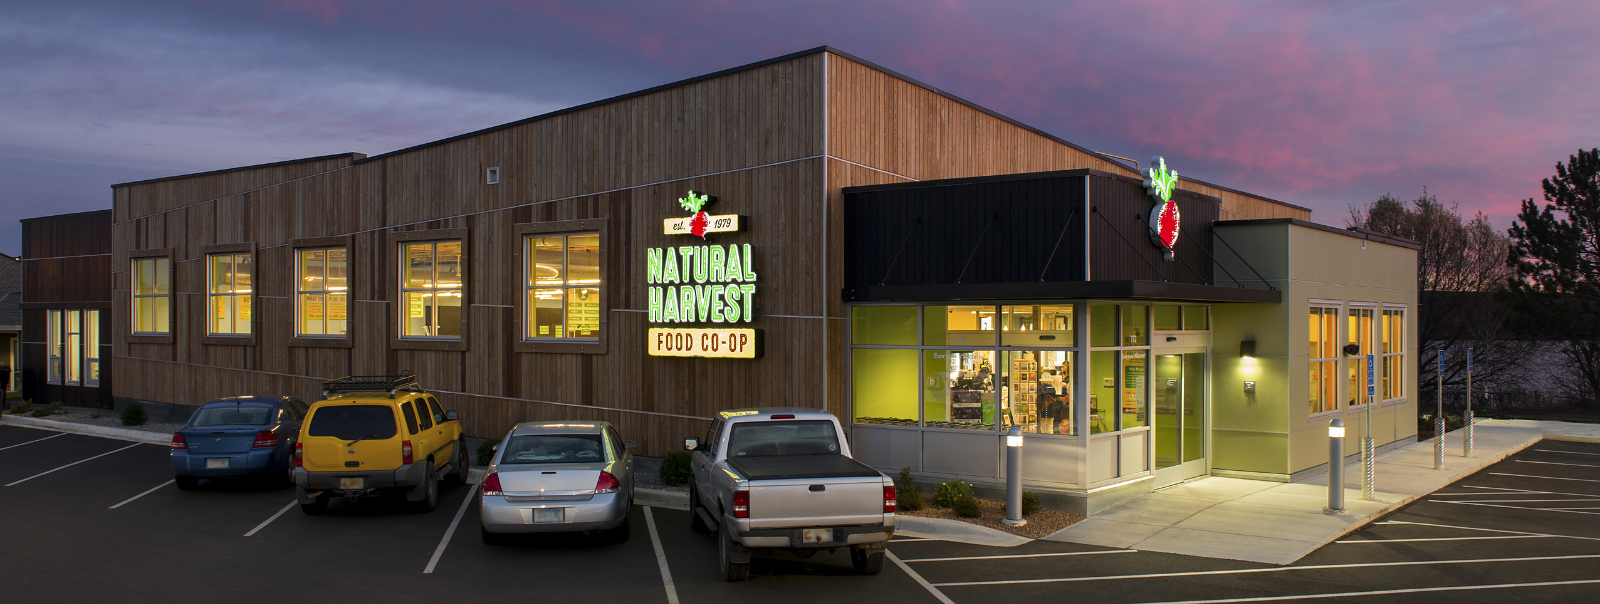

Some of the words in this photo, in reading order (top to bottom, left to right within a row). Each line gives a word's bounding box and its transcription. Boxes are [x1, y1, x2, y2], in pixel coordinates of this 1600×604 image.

[672, 220, 686, 231] est.
[714, 217, 732, 229] 1979
[648, 244, 756, 283] NATURAL
[648, 284, 756, 323] HARVEST
[657, 332, 693, 352] FOOD
[701, 332, 748, 353] CO-OP
[952, 334, 967, 343] 732
